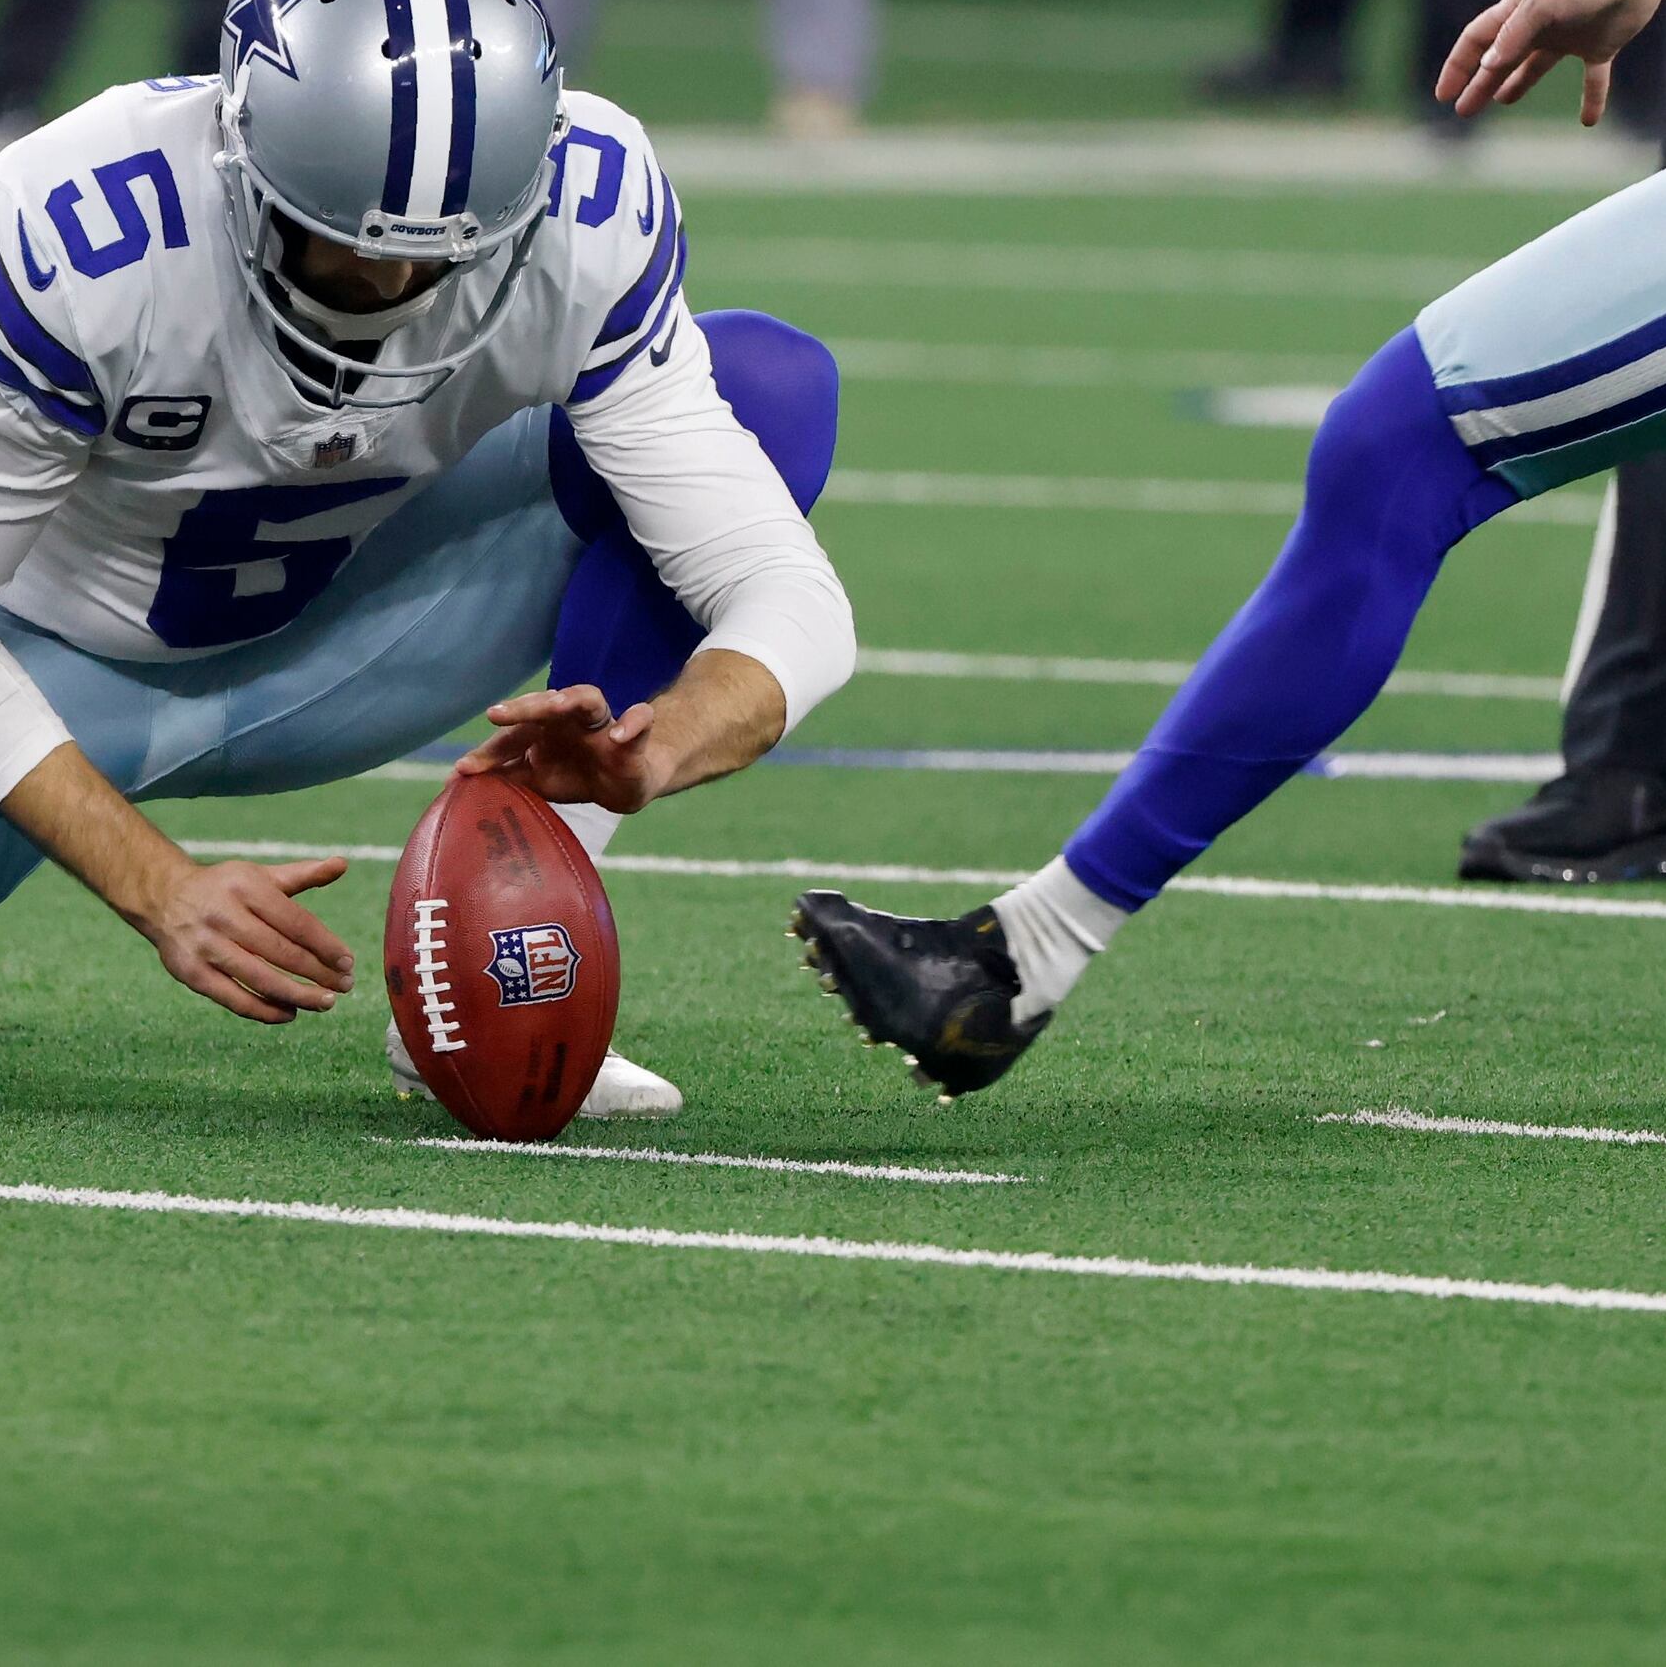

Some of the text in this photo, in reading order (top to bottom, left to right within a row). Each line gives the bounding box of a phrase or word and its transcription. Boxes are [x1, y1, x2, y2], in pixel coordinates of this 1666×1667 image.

[44, 147, 190, 276] 5
[390, 223, 447, 236] COWBOYS
[125, 400, 204, 438] C
[527, 931, 569, 995] NFL
